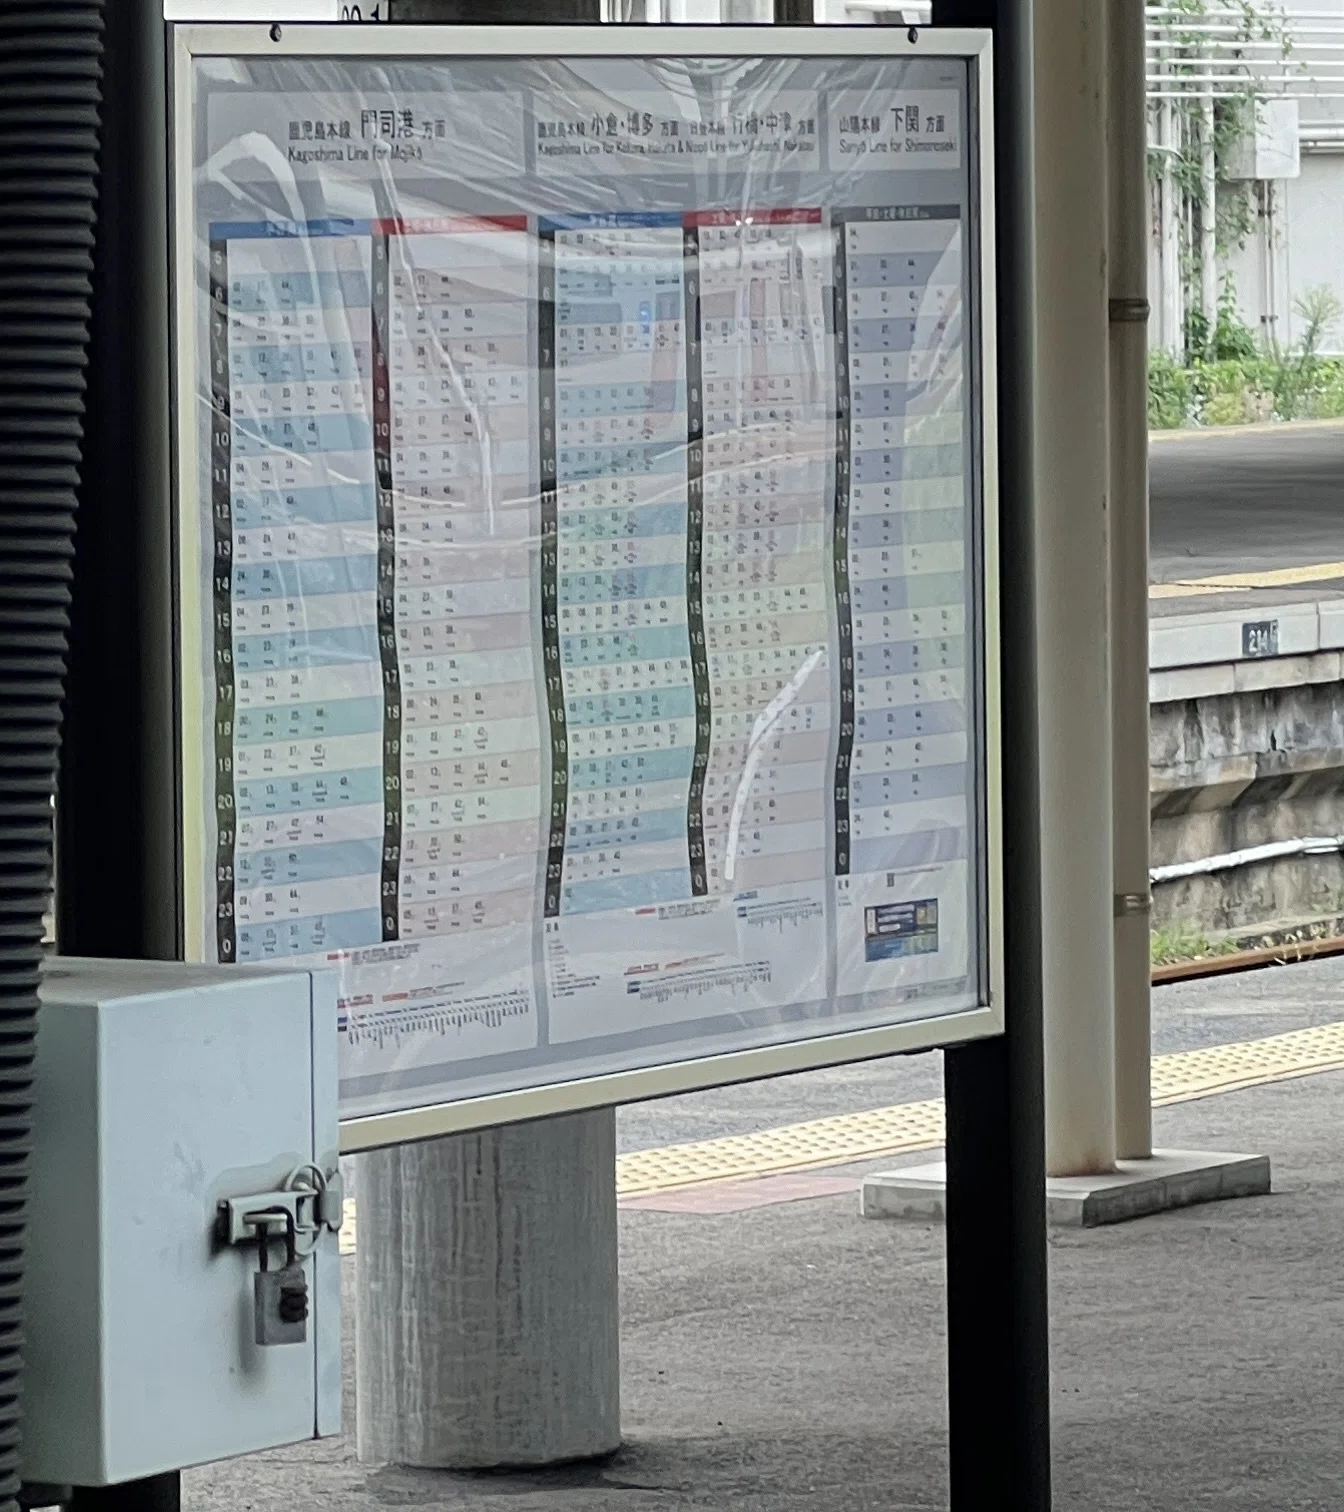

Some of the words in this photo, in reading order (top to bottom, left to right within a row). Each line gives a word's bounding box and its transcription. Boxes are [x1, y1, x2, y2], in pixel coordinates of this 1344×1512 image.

[375, 423, 388, 437] 10
[215, 432, 229, 447] 10
[377, 459, 389, 472] 11
[215, 469, 227, 482] 11
[379, 494, 391, 508] 12
[215, 504, 230, 519] 12
[216, 541, 230, 555] 13
[380, 564, 392, 578] 14
[216, 576, 229, 592] 14
[379, 598, 392, 614] 15
[217, 614, 230, 629] 15
[381, 634, 395, 649] 16
[217, 650, 231, 664] 16
[384, 669, 398, 685] 17
[219, 685, 232, 700] 17
[386, 704, 399, 719] 18
[217, 721, 231, 736] 18
[386, 740, 399, 755] 19
[218, 757, 231, 772] 19
[385, 776, 399, 790] 20
[218, 794, 232, 809] 20
[386, 811, 399, 826] 21
[220, 830, 233, 845] 21
[384, 846, 399, 861] 22
[218, 866, 232, 881] 22
[382, 880, 396, 896] 23
[218, 902, 233, 918] 23
